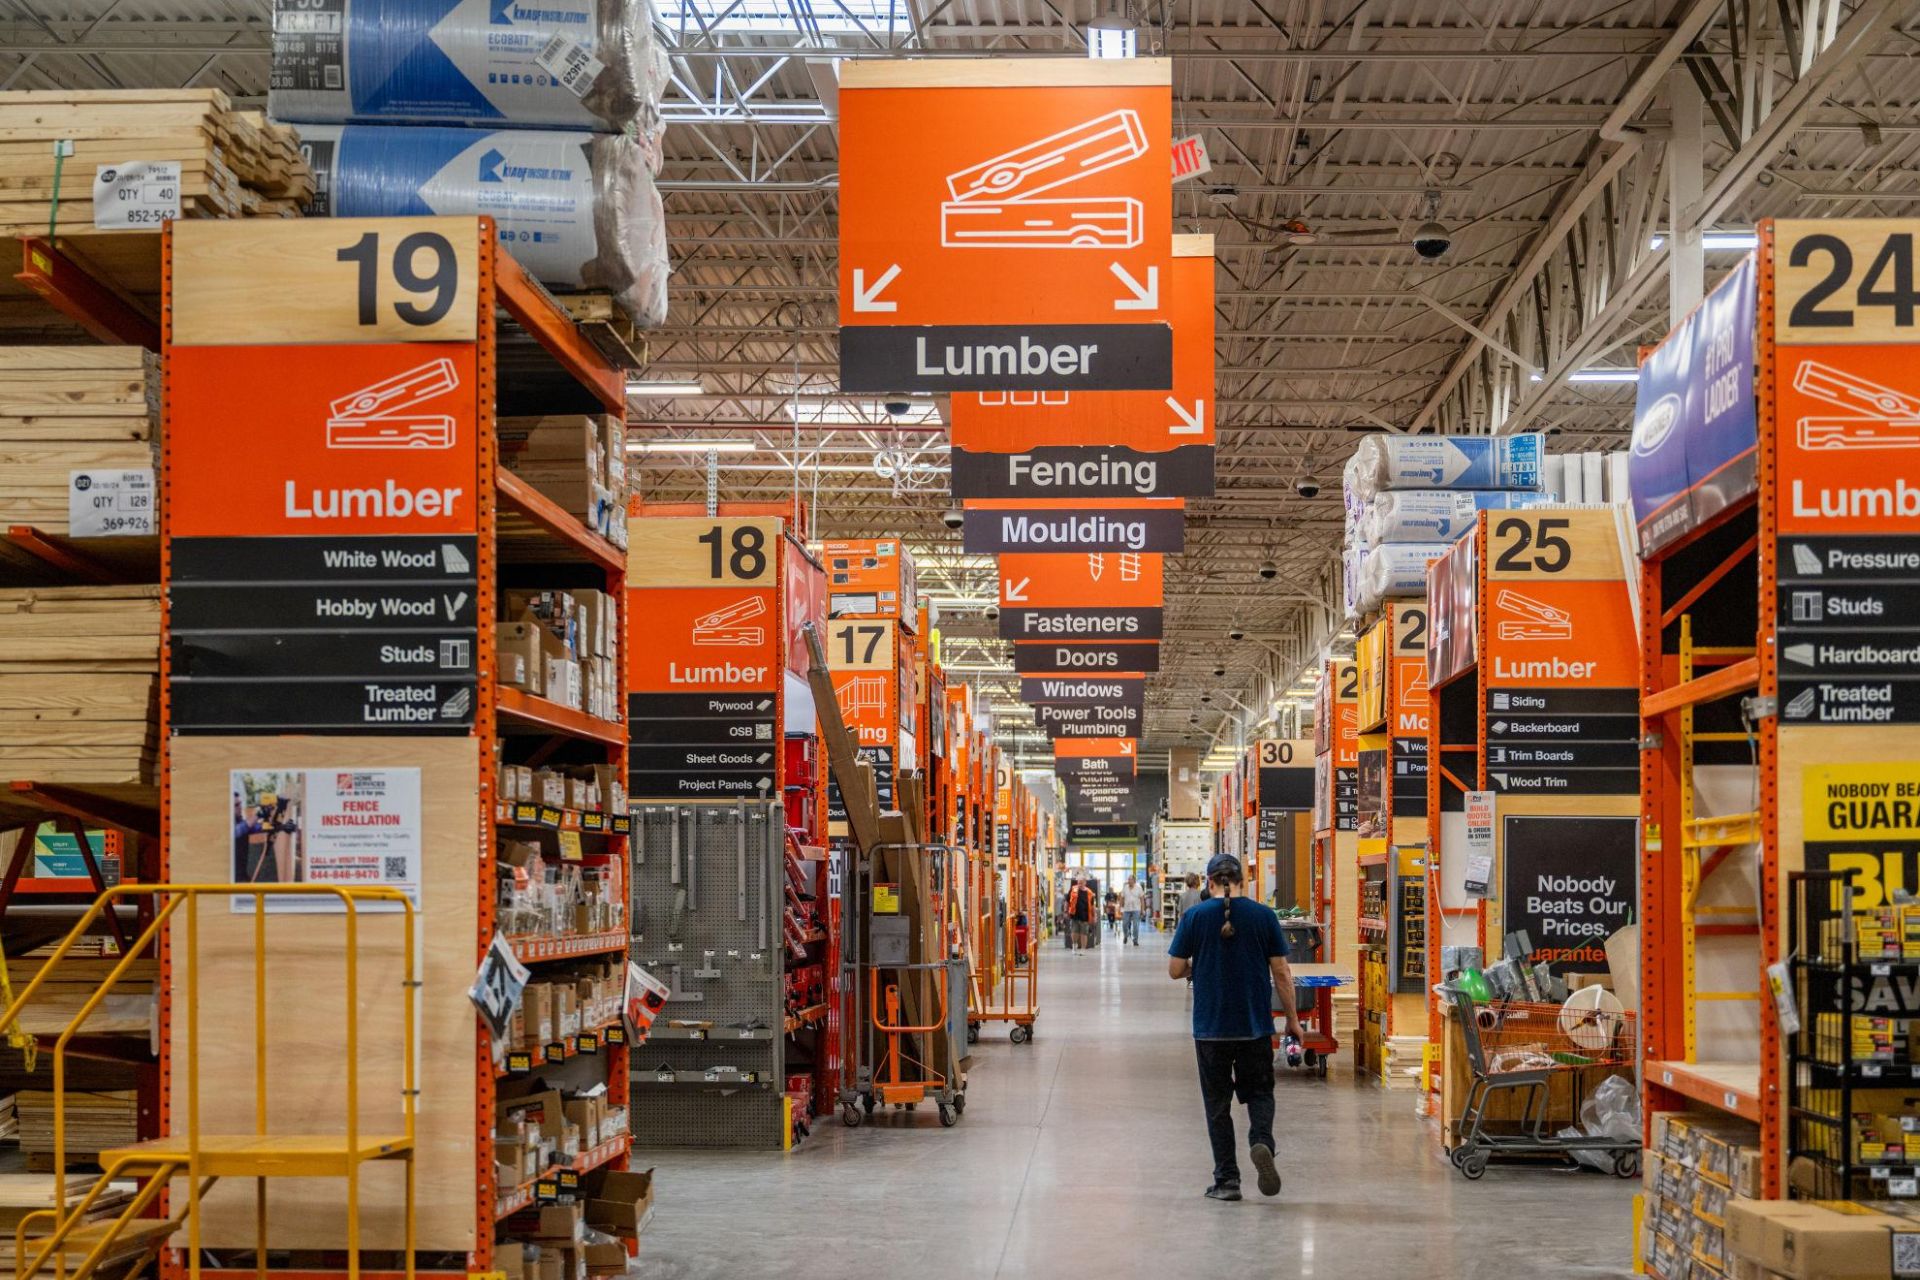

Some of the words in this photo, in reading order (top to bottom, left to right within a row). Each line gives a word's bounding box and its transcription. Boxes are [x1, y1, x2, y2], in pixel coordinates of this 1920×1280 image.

[563, 53, 591, 85] 814628
[1172, 139, 1200, 178] XIT
[118, 189, 139, 200] QTY
[159, 188, 174, 199] 40
[128, 210, 175, 223] 852-562
[336, 231, 459, 327] 19
[1789, 233, 1920, 327] 24
[917, 336, 1098, 375] Lumber
[1009, 455, 1157, 494] Fencing
[93, 496, 113, 508] QTY
[130, 495, 148, 507] 128
[285, 479, 463, 518] Lumber
[1792, 479, 1920, 518] Lumb
[102, 517, 149, 530] 369-926
[1002, 517, 1146, 549] Moulding
[699, 526, 766, 580] 18
[1495, 518, 1571, 573] 25
[324, 550, 377, 567] White
[382, 550, 436, 567] Wood
[1828, 550, 1920, 568] Pressure
[316, 599, 376, 618] Hobby
[381, 599, 435, 616] Wood
[1827, 598, 1883, 615] Studs
[1024, 612, 1139, 632] Fasteners
[1400, 609, 1427, 650] 2
[836, 626, 885, 664] 17
[380, 646, 435, 663] Studs
[1056, 648, 1119, 666] Doors
[1819, 646, 1920, 663] Hardboard
[669, 662, 768, 684] Lumber
[1495, 656, 1597, 679] Lumber
[1042, 681, 1123, 698] Windows
[1340, 667, 1357, 698] 2
[365, 685, 435, 702] Treated
[1819, 684, 1891, 701] Treated
[709, 700, 753, 712] Plywood
[1512, 696, 1545, 709] Siding
[364, 704, 436, 721] Lumber
[1042, 706, 1090, 720] Power
[1095, 705, 1137, 720] Tools
[1819, 704, 1895, 721] Lumber
[729, 727, 753, 737] OSB
[1062, 724, 1126, 737] Plumbing
[1510, 722, 1580, 734] Backerboard
[686, 754, 717, 765] Sheet
[719, 754, 752, 765] Goods
[1263, 742, 1293, 764] 30
[1509, 750, 1532, 761] Trim
[1535, 750, 1574, 761] Boards
[1082, 759, 1108, 769] Bath
[679, 780, 716, 791] Project
[718, 780, 752, 790] Panels
[1510, 777, 1541, 787] Wood
[1544, 777, 1568, 787] Trim
[1828, 783, 1890, 798] NOBODY
[1080, 787, 1130, 797] Appliances
[343, 801, 379, 812] FENCE
[1828, 800, 1920, 829] GUAR
[322, 815, 400, 826] INSTALLATION
[1538, 875, 1616, 896] Nobody
[1527, 896, 1584, 914] Beats
[1589, 896, 1627, 915] Our
[1542, 919, 1610, 936] Prices.
[1529, 946, 1608, 962] uarante
